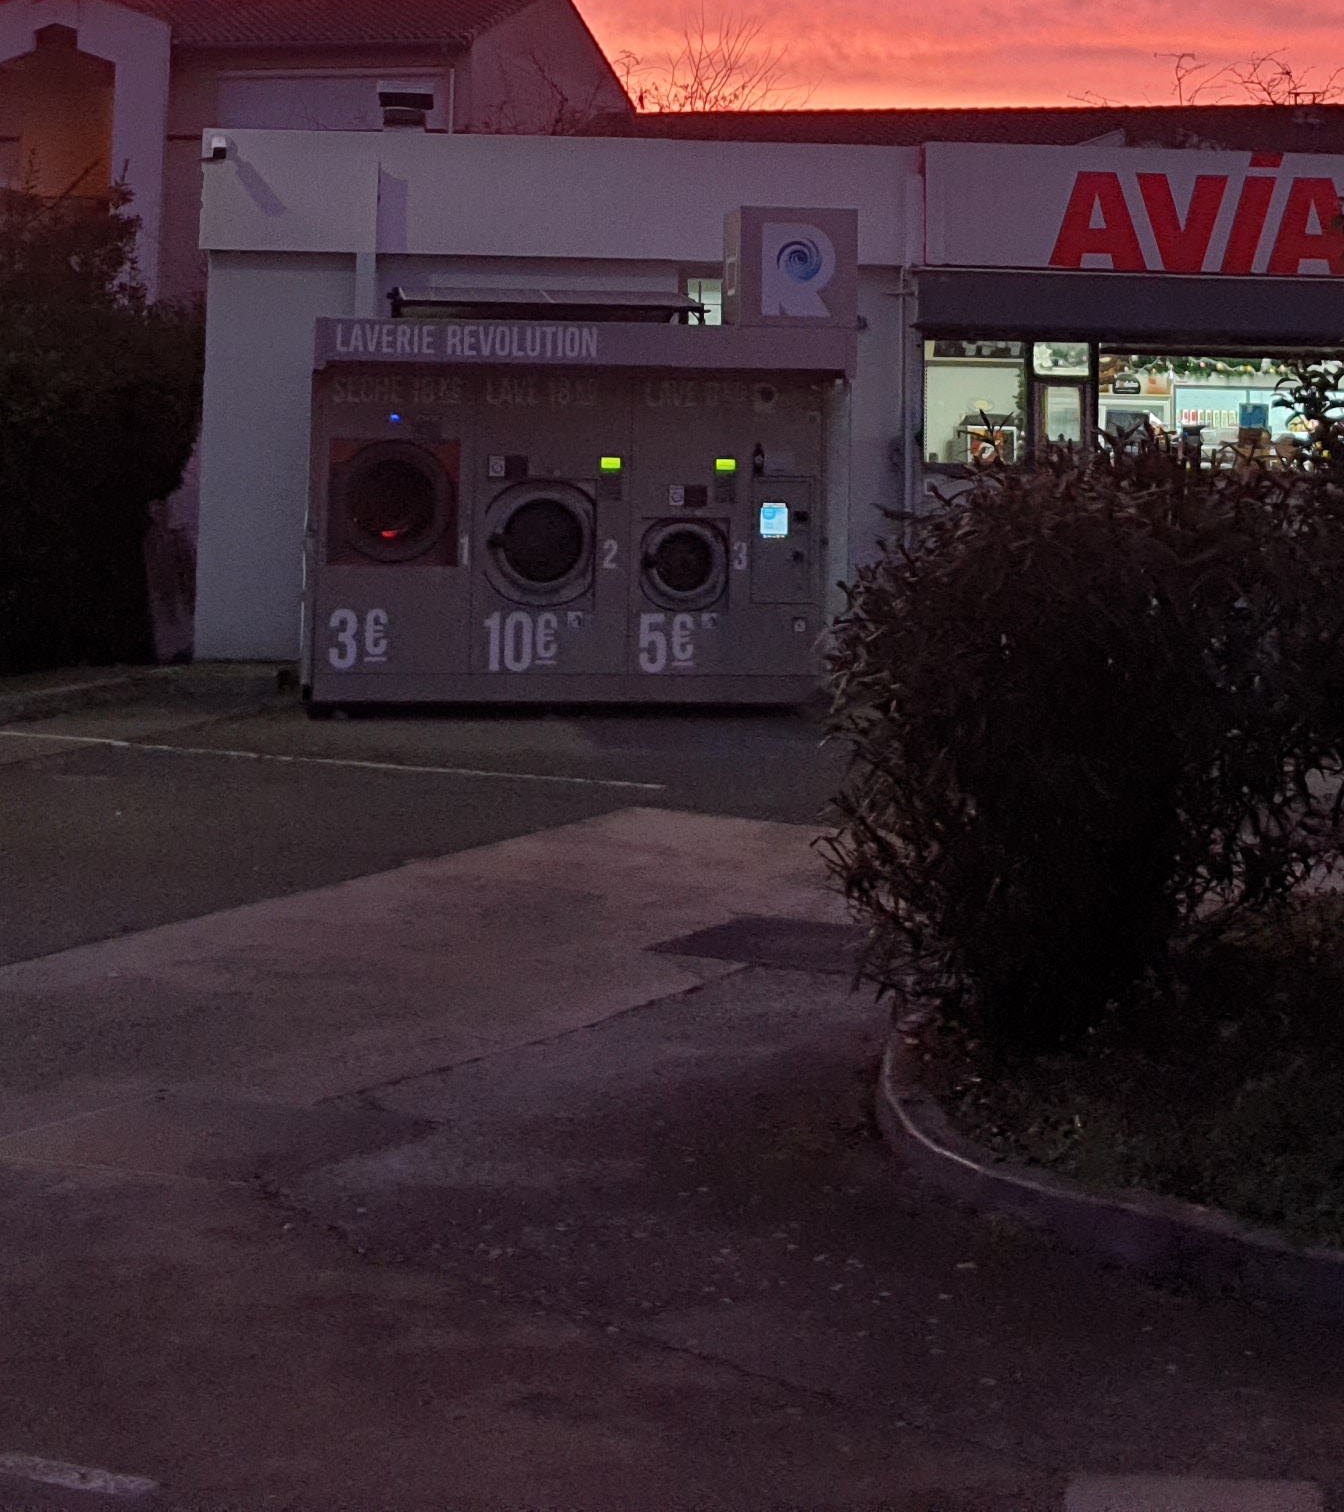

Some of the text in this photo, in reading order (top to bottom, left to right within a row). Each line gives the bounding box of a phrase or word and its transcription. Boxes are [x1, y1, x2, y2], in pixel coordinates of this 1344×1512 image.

[335, 323, 599, 358] LAVERIE REVOLUTION
[602, 538, 618, 570] 2
[732, 541, 748, 571] 3
[483, 610, 558, 672] 10€
